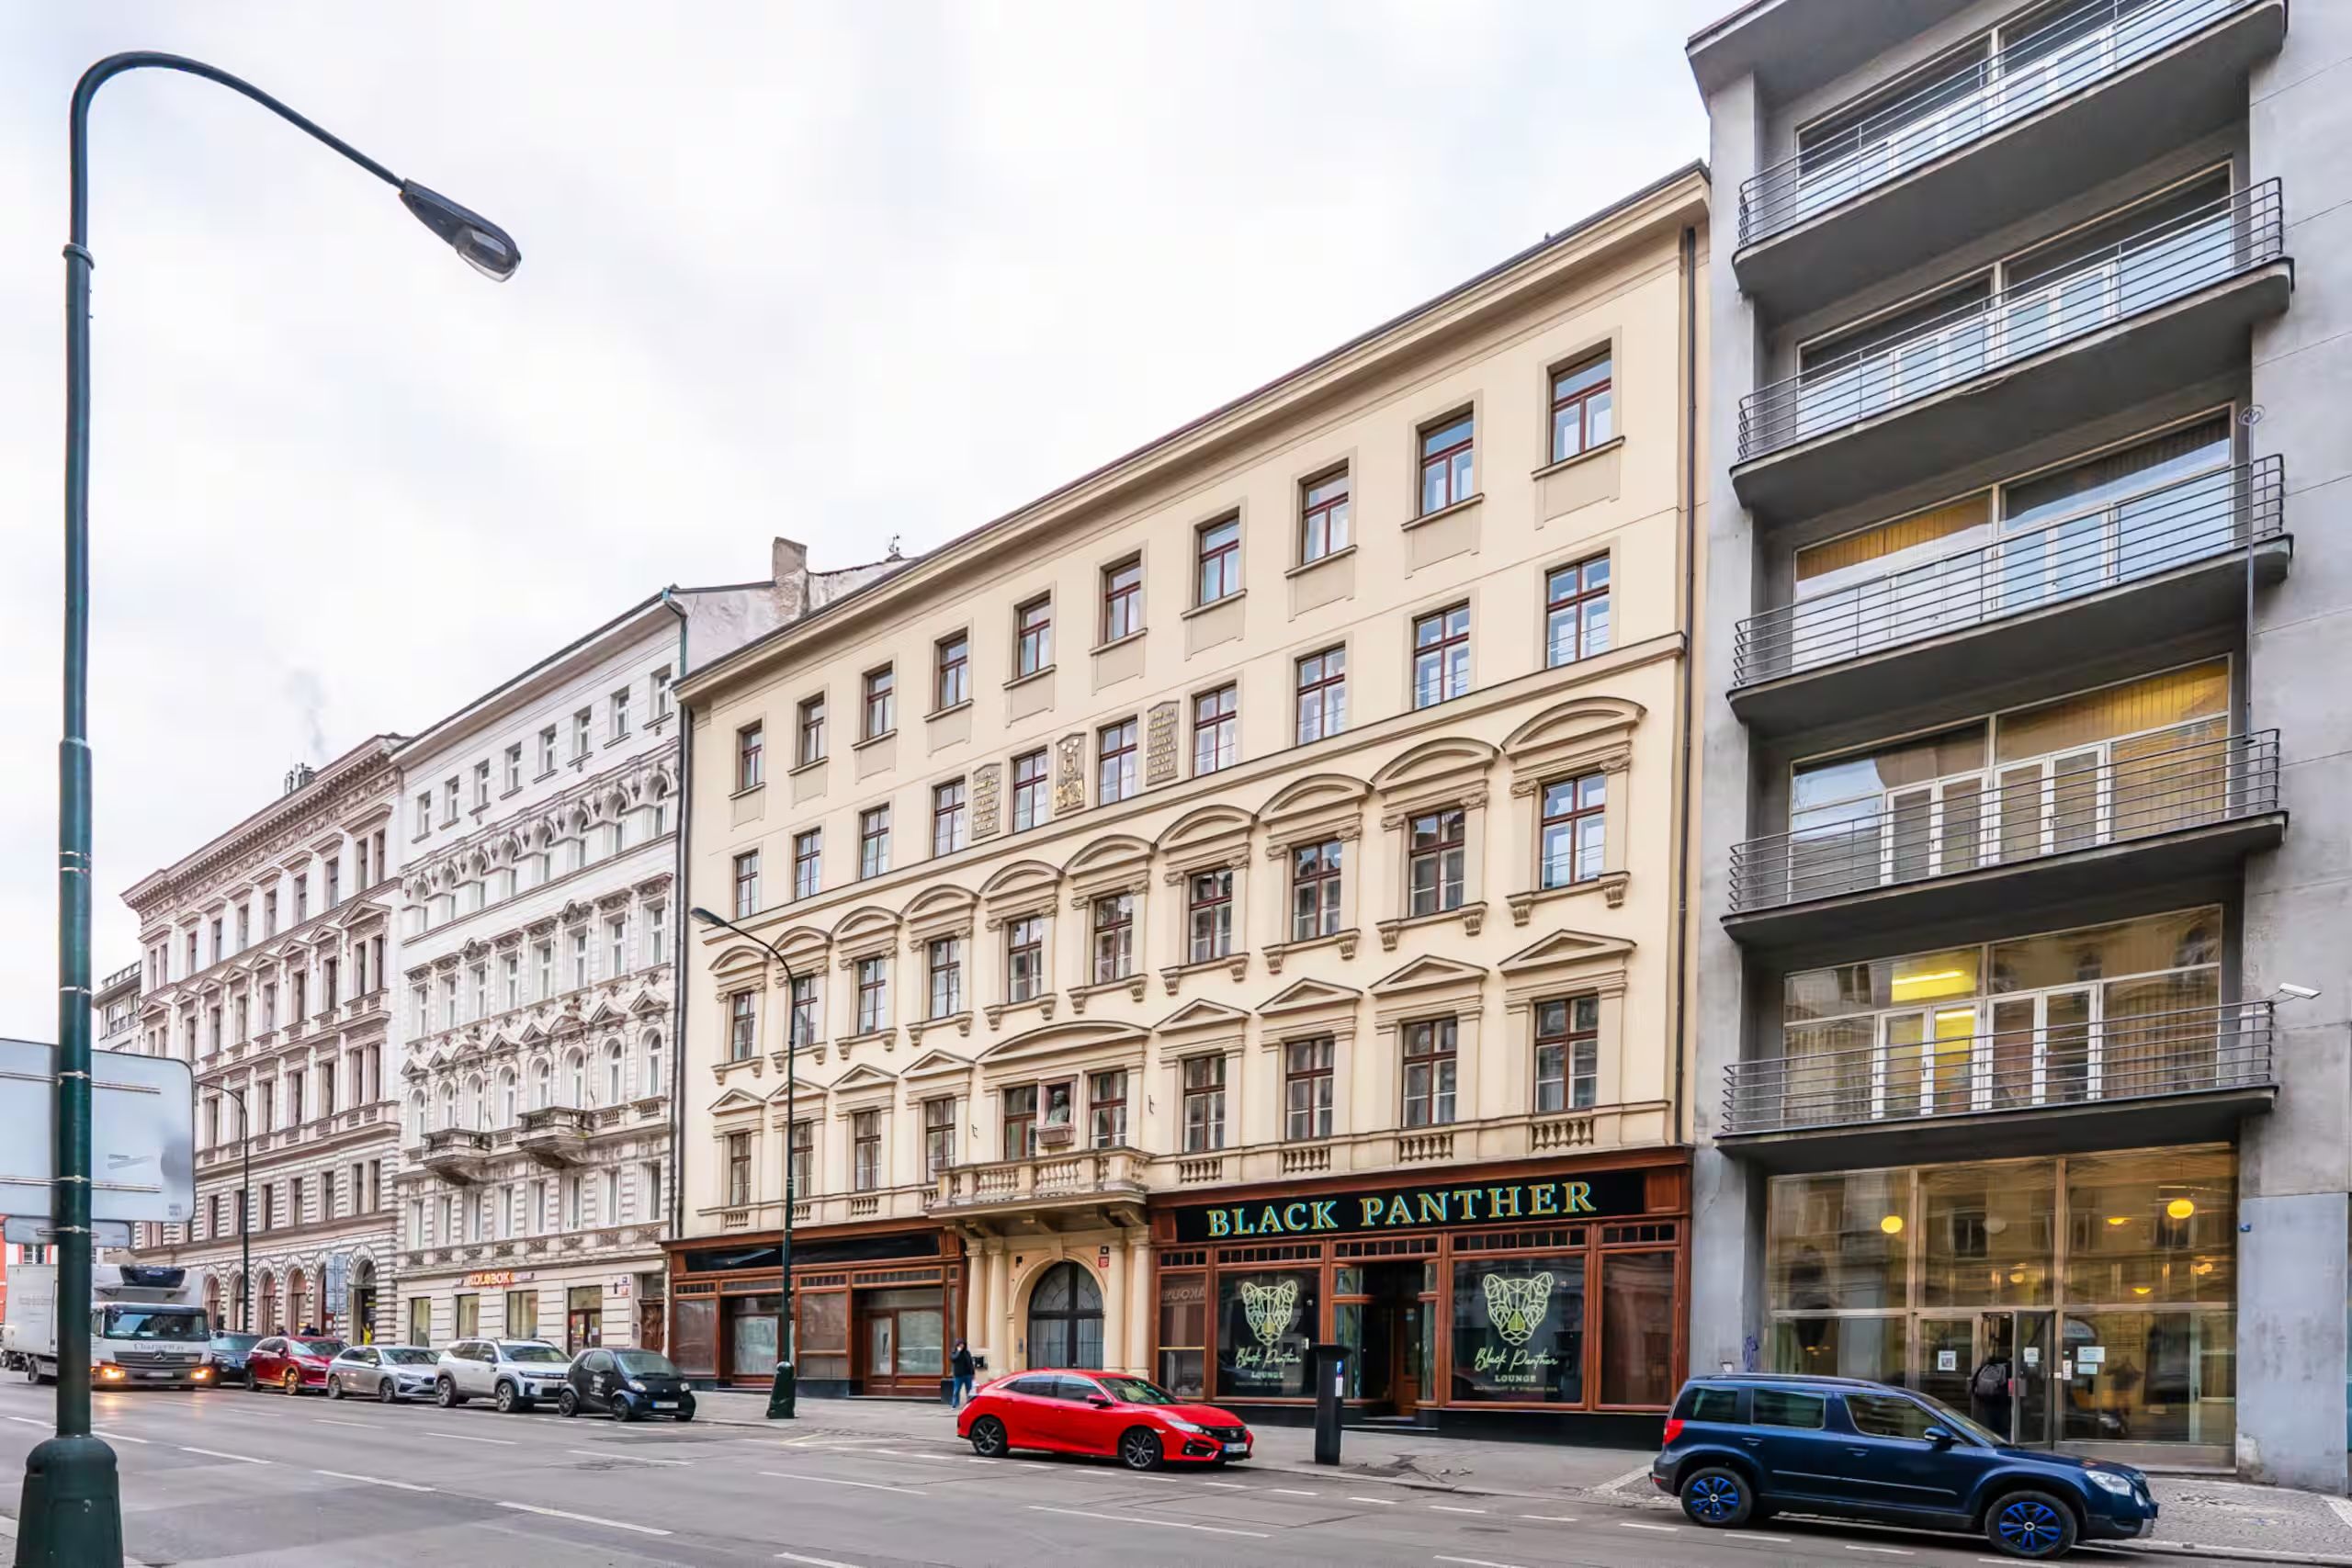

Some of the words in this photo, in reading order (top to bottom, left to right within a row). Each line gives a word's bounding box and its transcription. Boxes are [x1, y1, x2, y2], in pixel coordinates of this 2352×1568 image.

[1206, 1200, 1339, 1236] BLACK
[1359, 1180, 1597, 1226] PANTHER
[1475, 1347, 1507, 1371] Black
[1509, 1348, 1559, 1371] Panther
[1250, 1371, 1284, 1380] LOUNGE
[1494, 1374, 1537, 1382] LOUNGE
